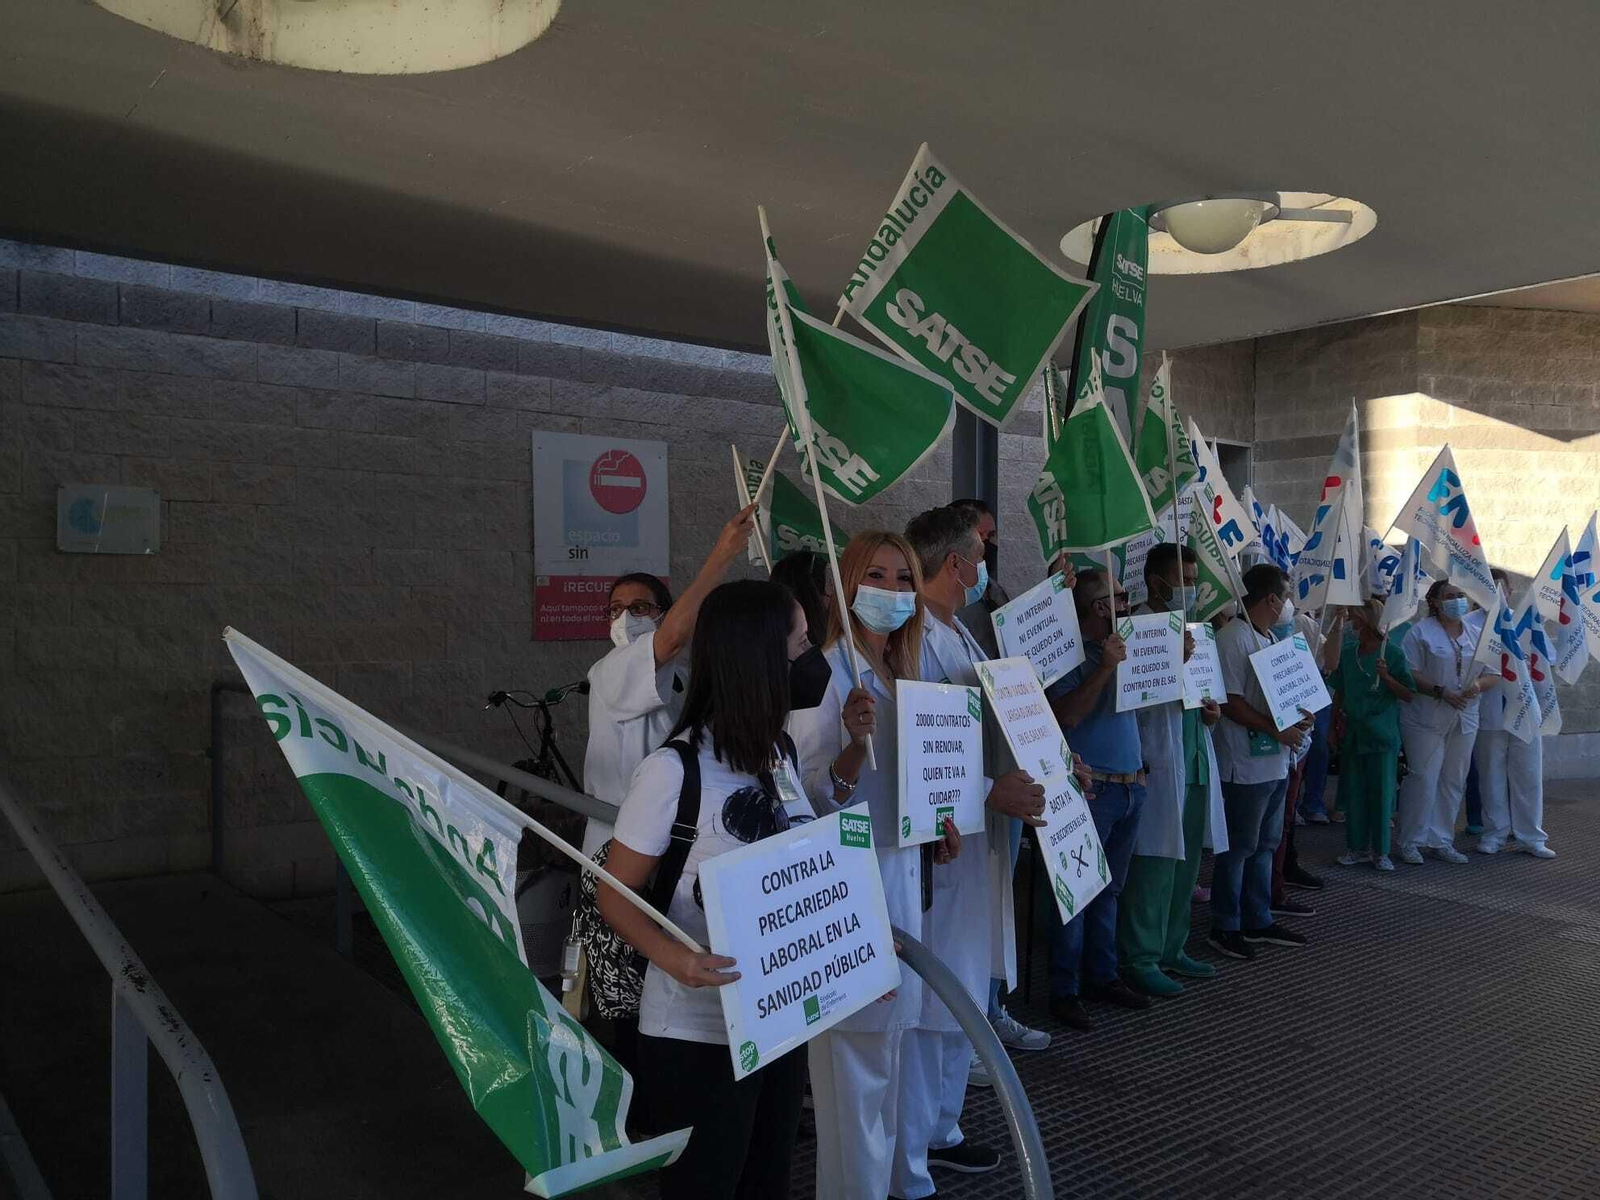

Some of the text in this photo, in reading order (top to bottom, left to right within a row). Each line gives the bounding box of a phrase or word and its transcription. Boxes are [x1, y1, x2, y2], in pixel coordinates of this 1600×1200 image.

[842, 164, 946, 303] Andalucía
[886, 287, 1017, 406] SATSE
[568, 530, 620, 544] espacio
[569, 545, 588, 559] sin
[563, 581, 613, 593] ¡RECUE
[1016, 614, 1025, 625] NI
[1024, 596, 1053, 622] INTERINO
[1019, 633, 1027, 645] NI
[1027, 614, 1058, 640] EVENTUAL,
[1135, 631, 1142, 640] NI
[1142, 628, 1167, 640] INTERINO
[1031, 635, 1053, 656] QUEDO
[1053, 628, 1064, 641] SIN
[1048, 652, 1057, 663] EN
[1056, 647, 1064, 658] EL
[1064, 639, 1075, 652] SAS
[1133, 648, 1140, 658] NI
[1270, 649, 1297, 668] CONTRA LA
[1131, 661, 1170, 675] ME QUEDO SIN
[1273, 661, 1304, 683] PRECARIEDAD
[1123, 674, 1177, 693] CONTRATO EN EL SAS
[1277, 678, 1299, 696] LABORAL
[1304, 673, 1311, 682] LA
[1279, 693, 1301, 711] SANIDAD
[935, 714, 971, 728] CONTRATOS
[922, 740, 965, 755] SIN RENOVAR,
[922, 767, 943, 783] QUIEN
[928, 788, 961, 806] CUIDAR???
[1049, 790, 1073, 814] BASTA YA
[841, 817, 869, 833] SATSE
[1050, 834, 1058, 846] DE
[761, 850, 835, 895] CONTRA LA
[758, 881, 848, 936] PRECARIEDAD
[760, 912, 861, 976] LABORAL EN LA
[757, 943, 876, 1019] SANIDAD PÚBLICA
